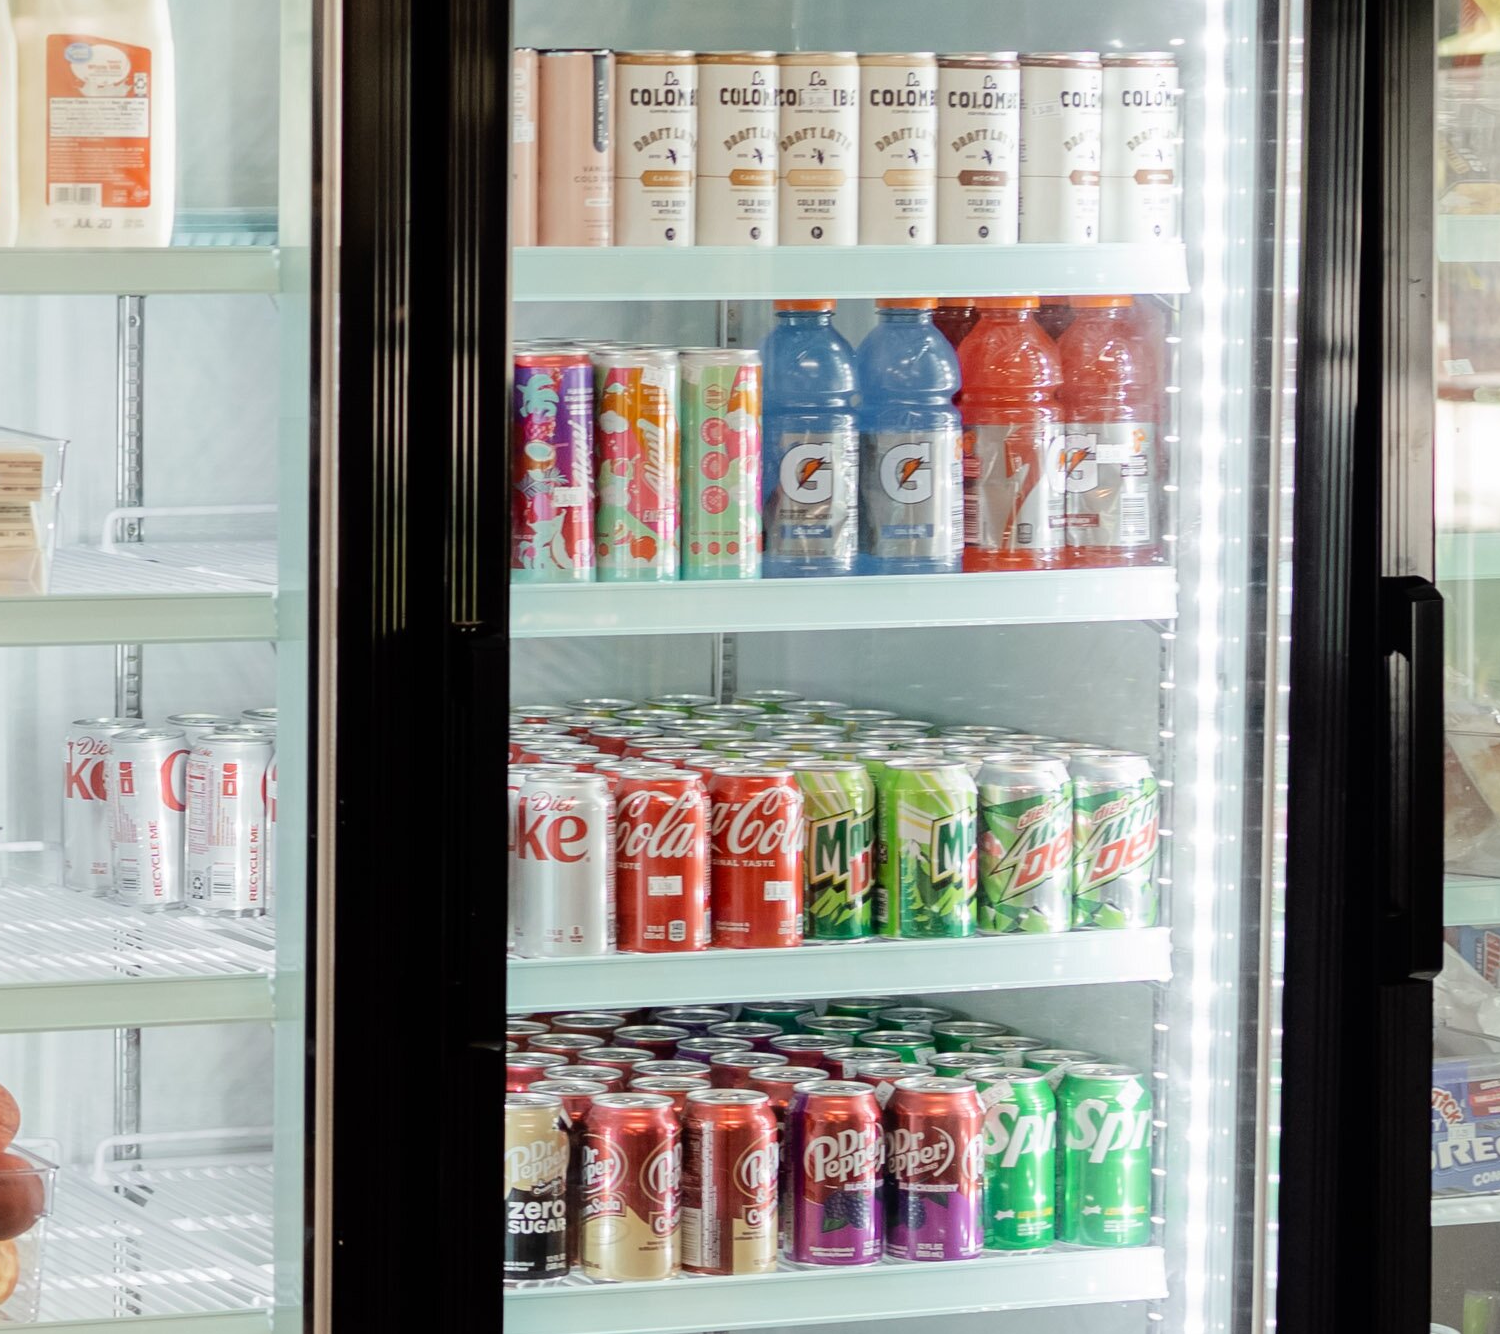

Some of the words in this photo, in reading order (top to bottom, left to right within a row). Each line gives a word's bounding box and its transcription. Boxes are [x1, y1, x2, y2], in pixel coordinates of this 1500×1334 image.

[664, 71, 680, 86] La
[751, 71, 766, 86] La
[809, 71, 827, 86] La
[905, 72, 920, 87] La
[982, 75, 997, 89] La
[871, 89, 937, 107] COLOMB
[633, 127, 671, 153] DRAFT
[723, 127, 758, 151] DRAFT
[780, 127, 817, 152] DRAFT
[875, 127, 912, 152] DRAFT
[951, 128, 988, 153] DRAFT
[779, 443, 833, 504] G
[879, 443, 933, 504] G
[531, 791, 575, 812] Diet
[1093, 798, 1129, 824] diet
[1019, 804, 1051, 829] diet
[147, 820, 160, 840] ME
[249, 824, 260, 845] ME
[518, 796, 589, 863] ke
[148, 842, 164, 898] RECYCLE
[248, 846, 260, 902] RECYCLE
[742, 859, 776, 868] TASTE
[531, 1140, 556, 1162] Dr
[838, 1128, 870, 1158] Dr
[894, 1128, 923, 1152] Dr
[508, 1199, 566, 1220] zero
[508, 1217, 566, 1234] SUGAR
